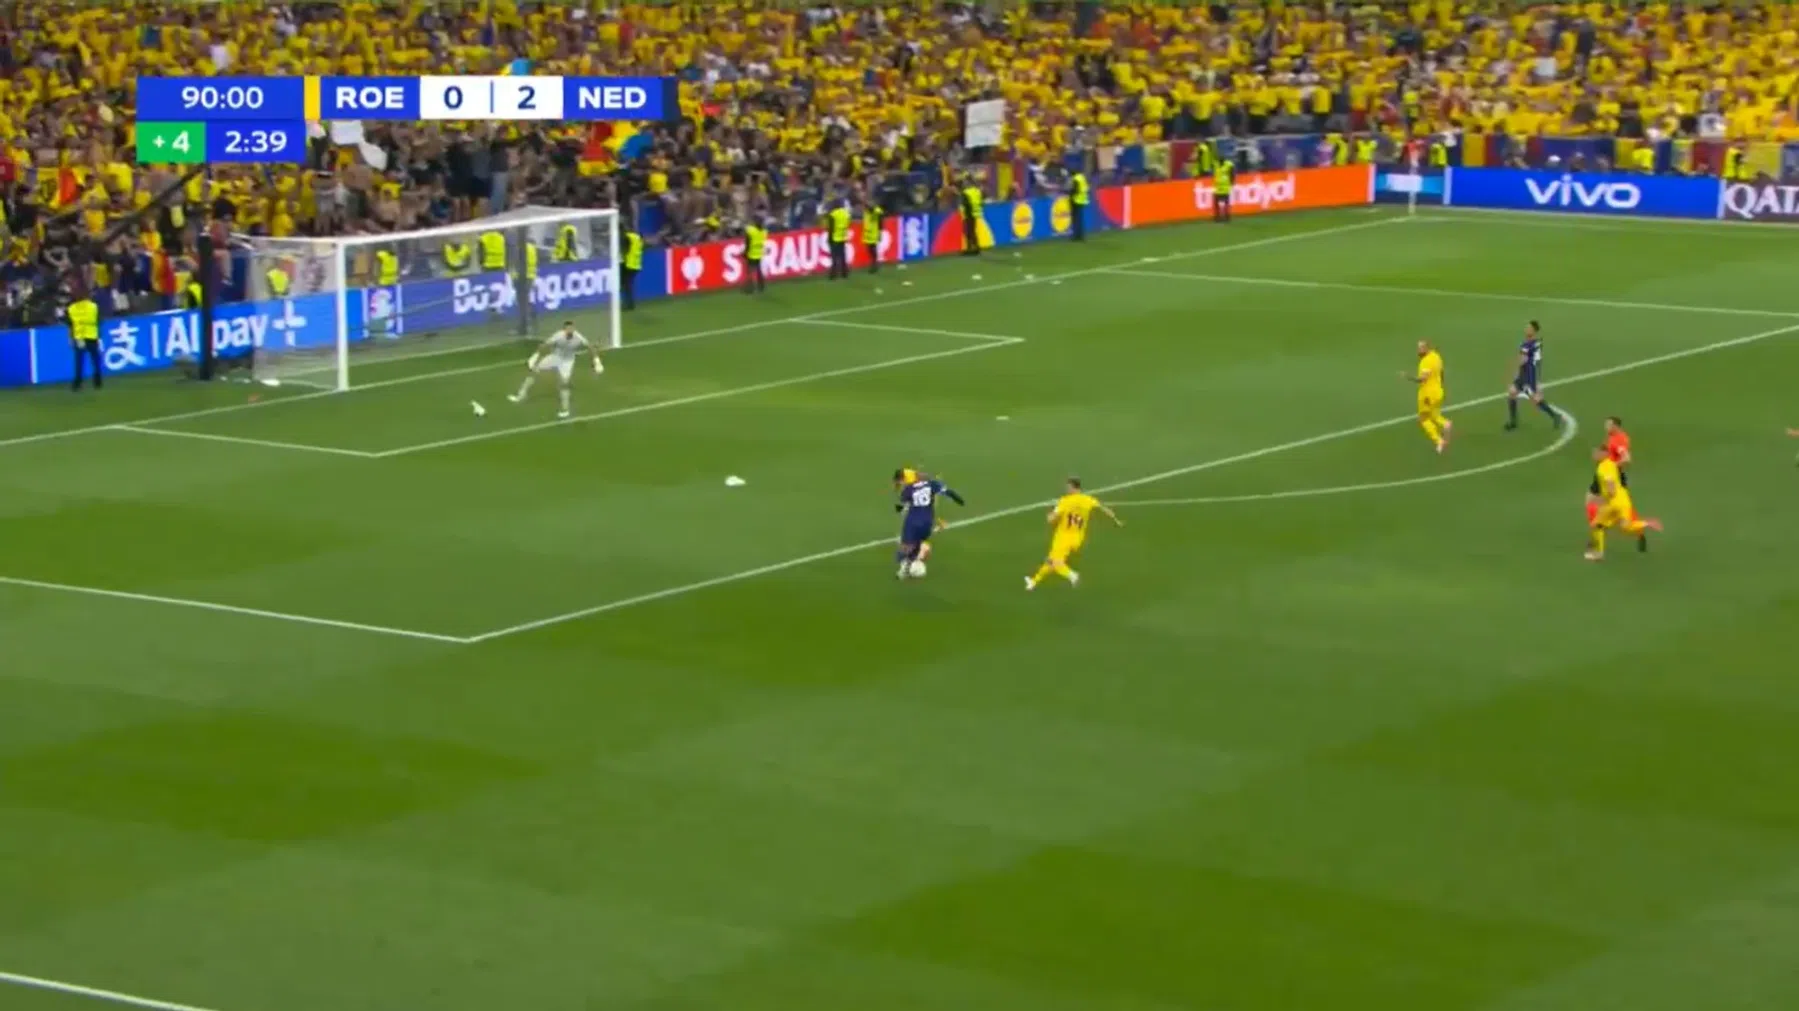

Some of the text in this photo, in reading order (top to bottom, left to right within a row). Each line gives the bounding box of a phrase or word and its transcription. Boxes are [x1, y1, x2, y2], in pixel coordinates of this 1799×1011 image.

[1193, 172, 1296, 209] trndyol
[1524, 173, 1641, 208] vivo
[1724, 183, 1799, 218] QAT
[453, 267, 612, 314] Bookng.com
